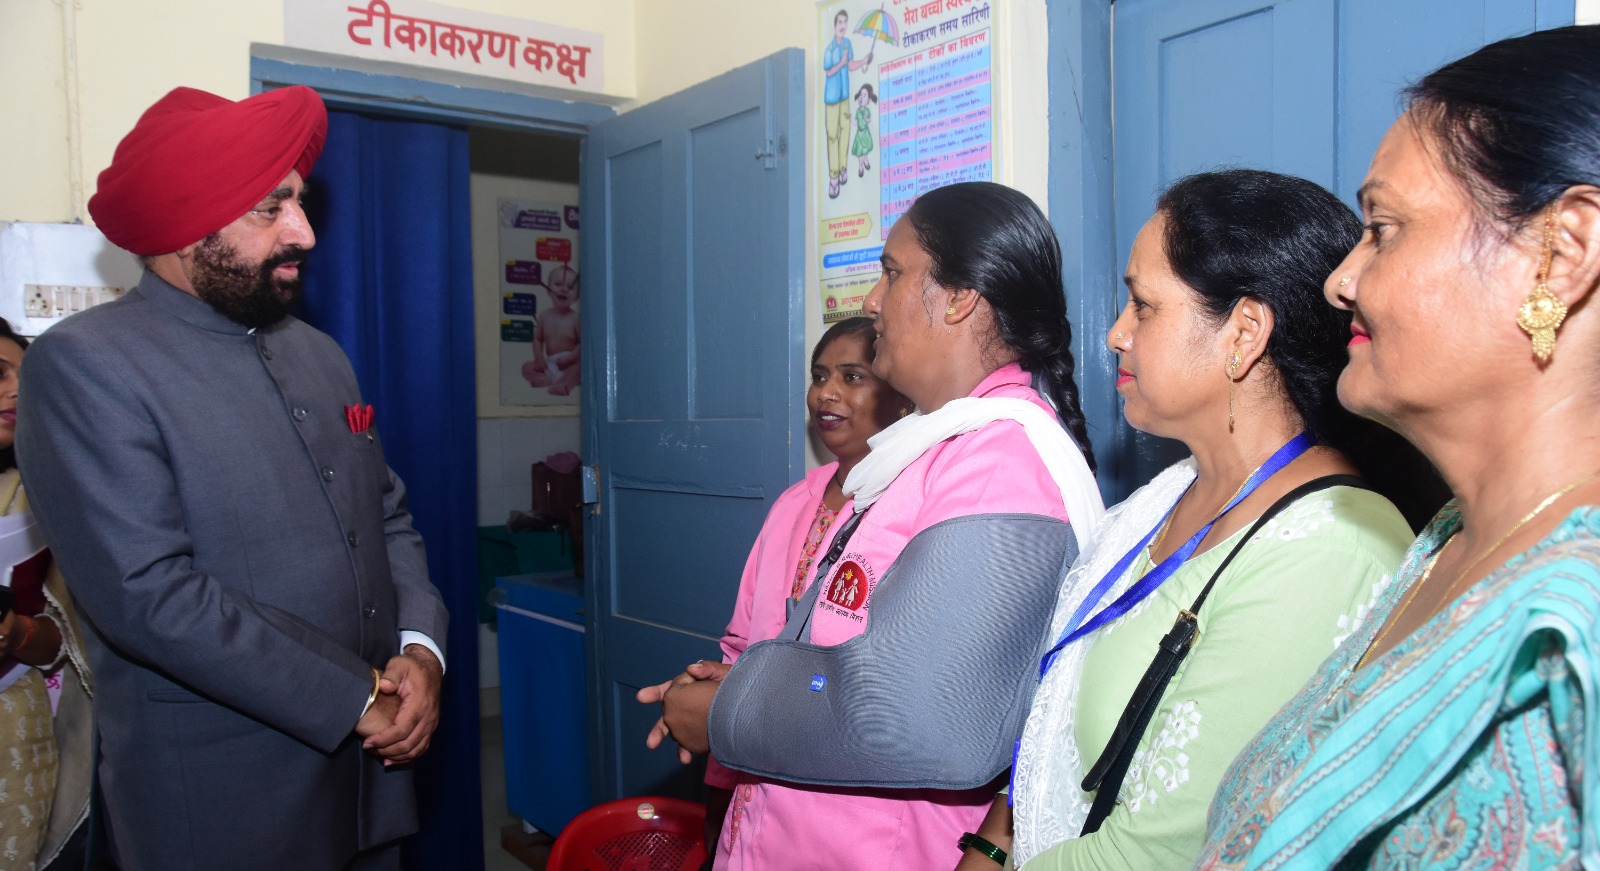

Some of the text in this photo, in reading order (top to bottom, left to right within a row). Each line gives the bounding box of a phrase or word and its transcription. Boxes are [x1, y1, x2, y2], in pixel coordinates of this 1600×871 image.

[902, 2, 990, 48] टीकाकरण समय सारिणी
[904, 6, 918, 25] मेरा
[347, 0, 591, 84] टीकाकरण कक्ष
[928, 31, 986, 60] टीकों का विवरण
